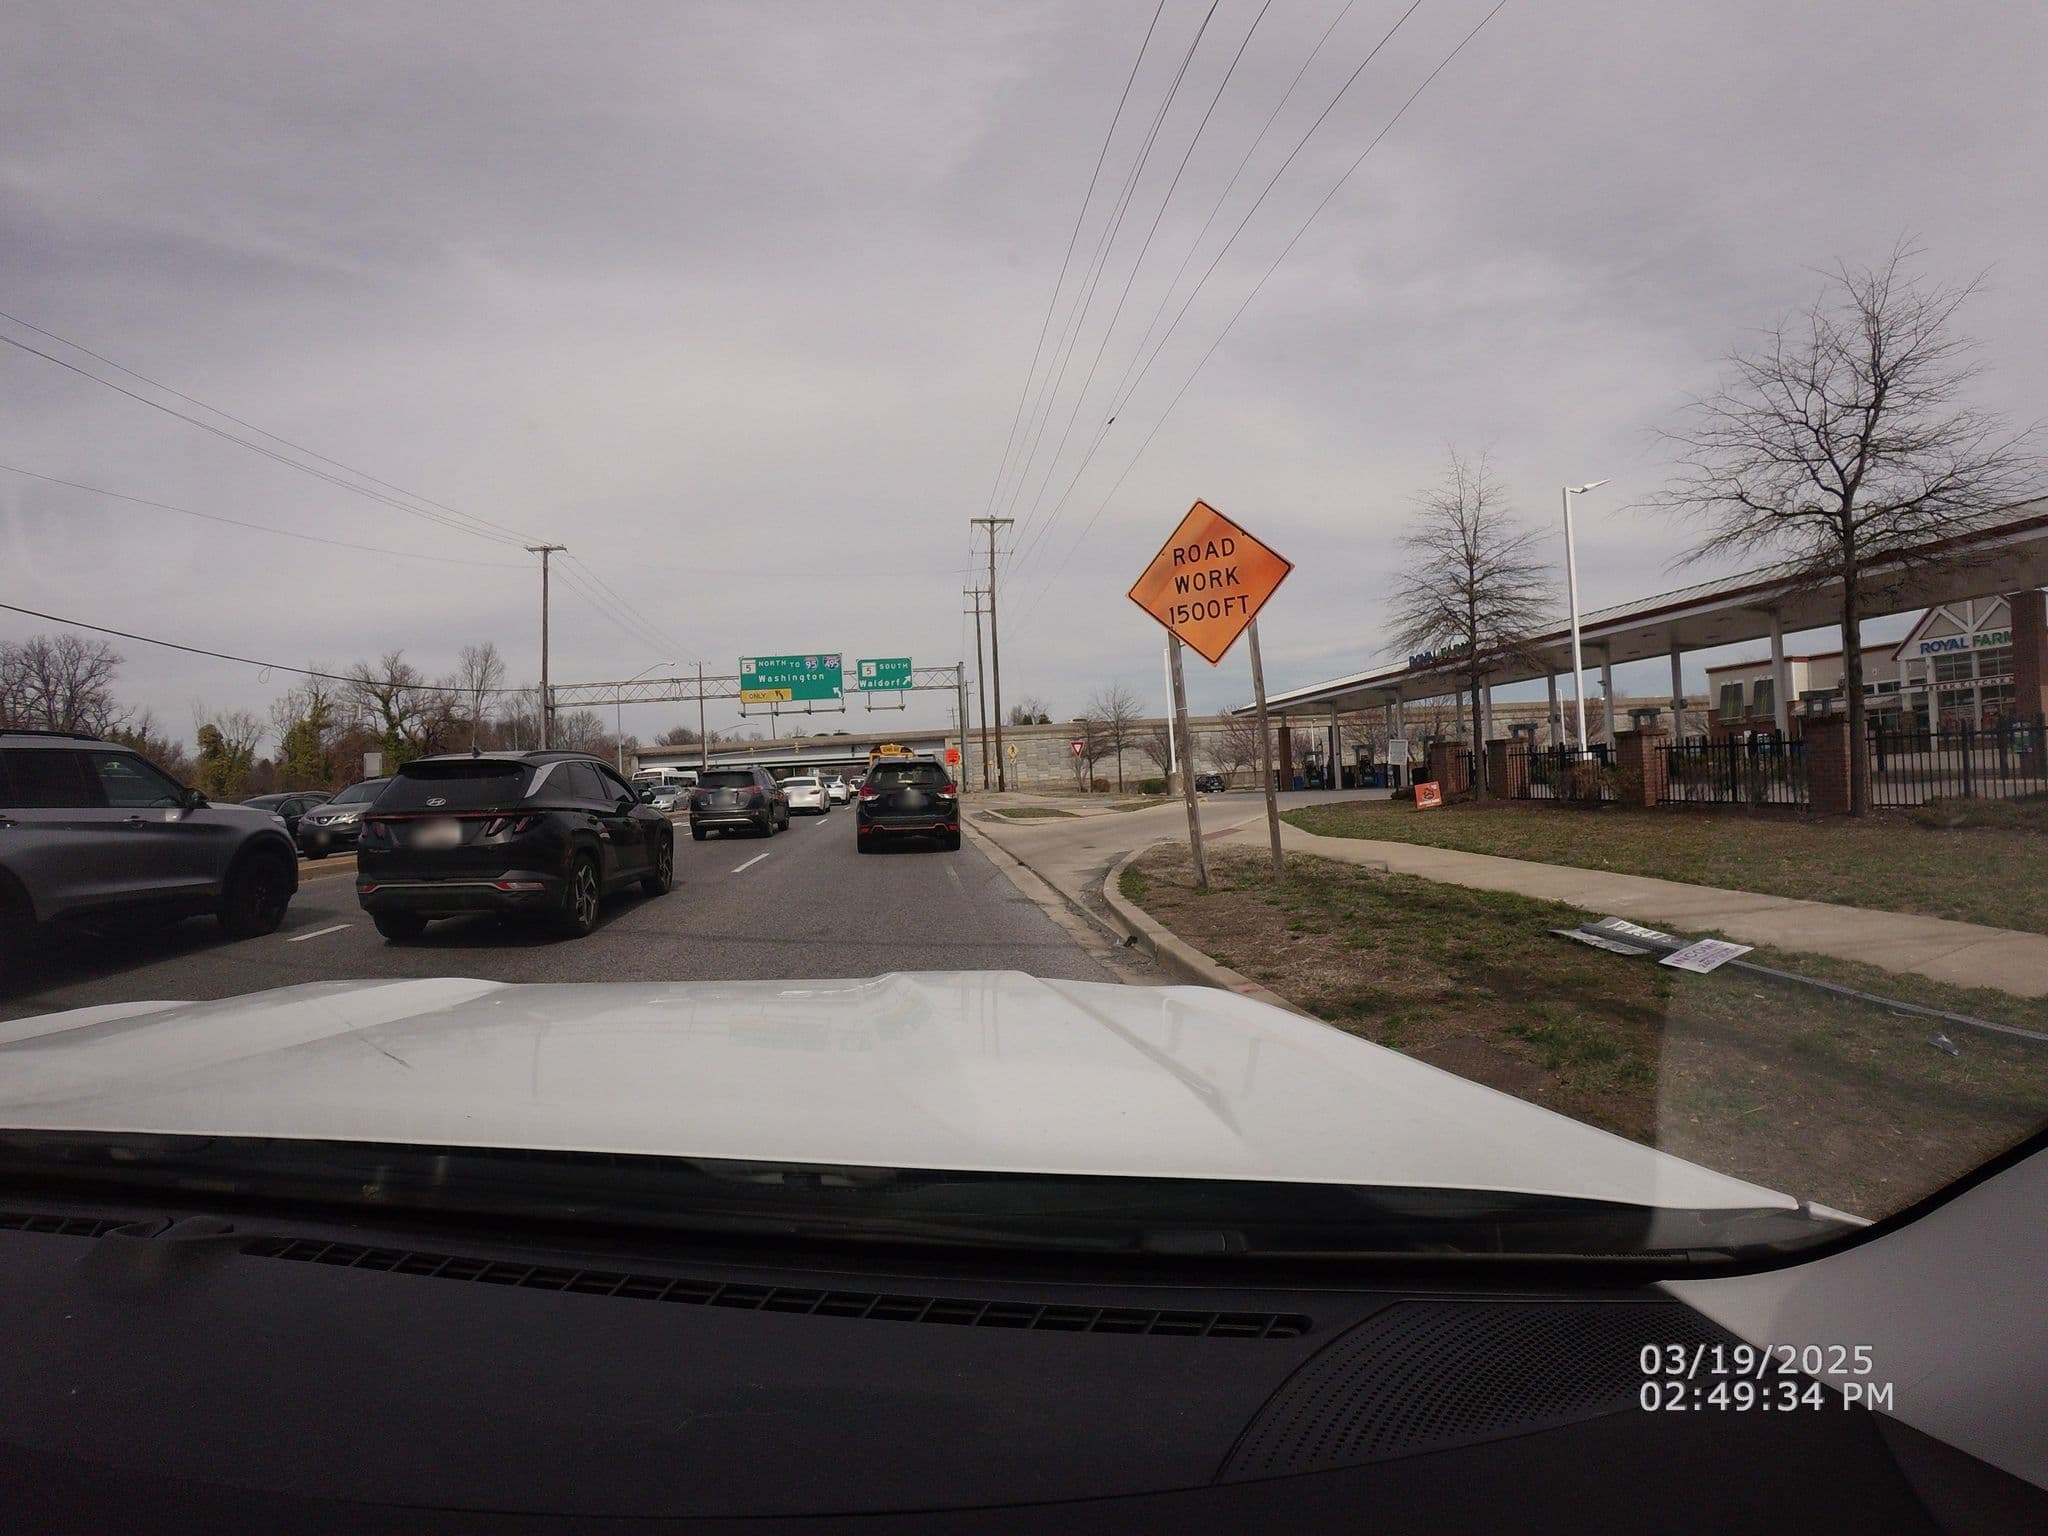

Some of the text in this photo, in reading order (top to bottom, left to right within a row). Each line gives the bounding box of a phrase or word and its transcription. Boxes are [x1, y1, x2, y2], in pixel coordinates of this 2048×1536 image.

[1173, 538, 1235, 566] ROAD
[1174, 566, 1240, 594] WORK
[1919, 630, 2012, 655] ROYAL FARM
[745, 665, 752, 673] 5
[805, 661, 817, 669] 95
[824, 660, 840, 668] 495
[866, 667, 872, 675] 5
[758, 673, 825, 683] Washington
[860, 678, 900, 688] Waldorf
